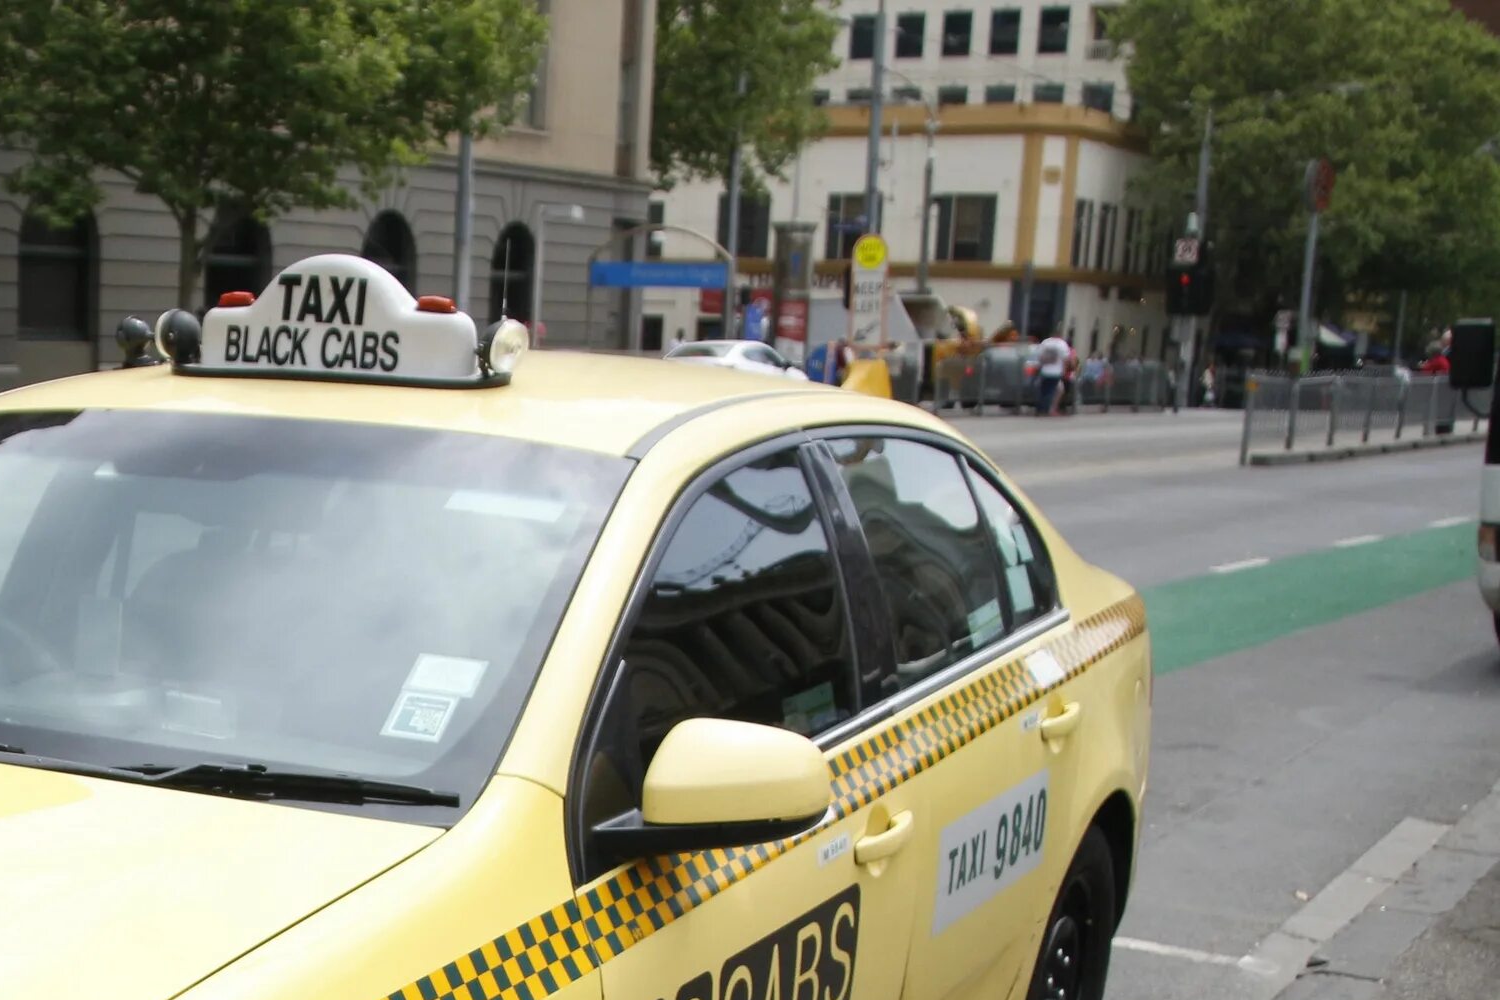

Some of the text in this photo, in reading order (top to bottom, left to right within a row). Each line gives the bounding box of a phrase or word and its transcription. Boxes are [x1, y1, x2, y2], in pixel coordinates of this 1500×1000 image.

[278, 273, 367, 326] TAXI
[225, 324, 400, 372] BLACK CABS
[948, 787, 1047, 896] TAXI 9840
